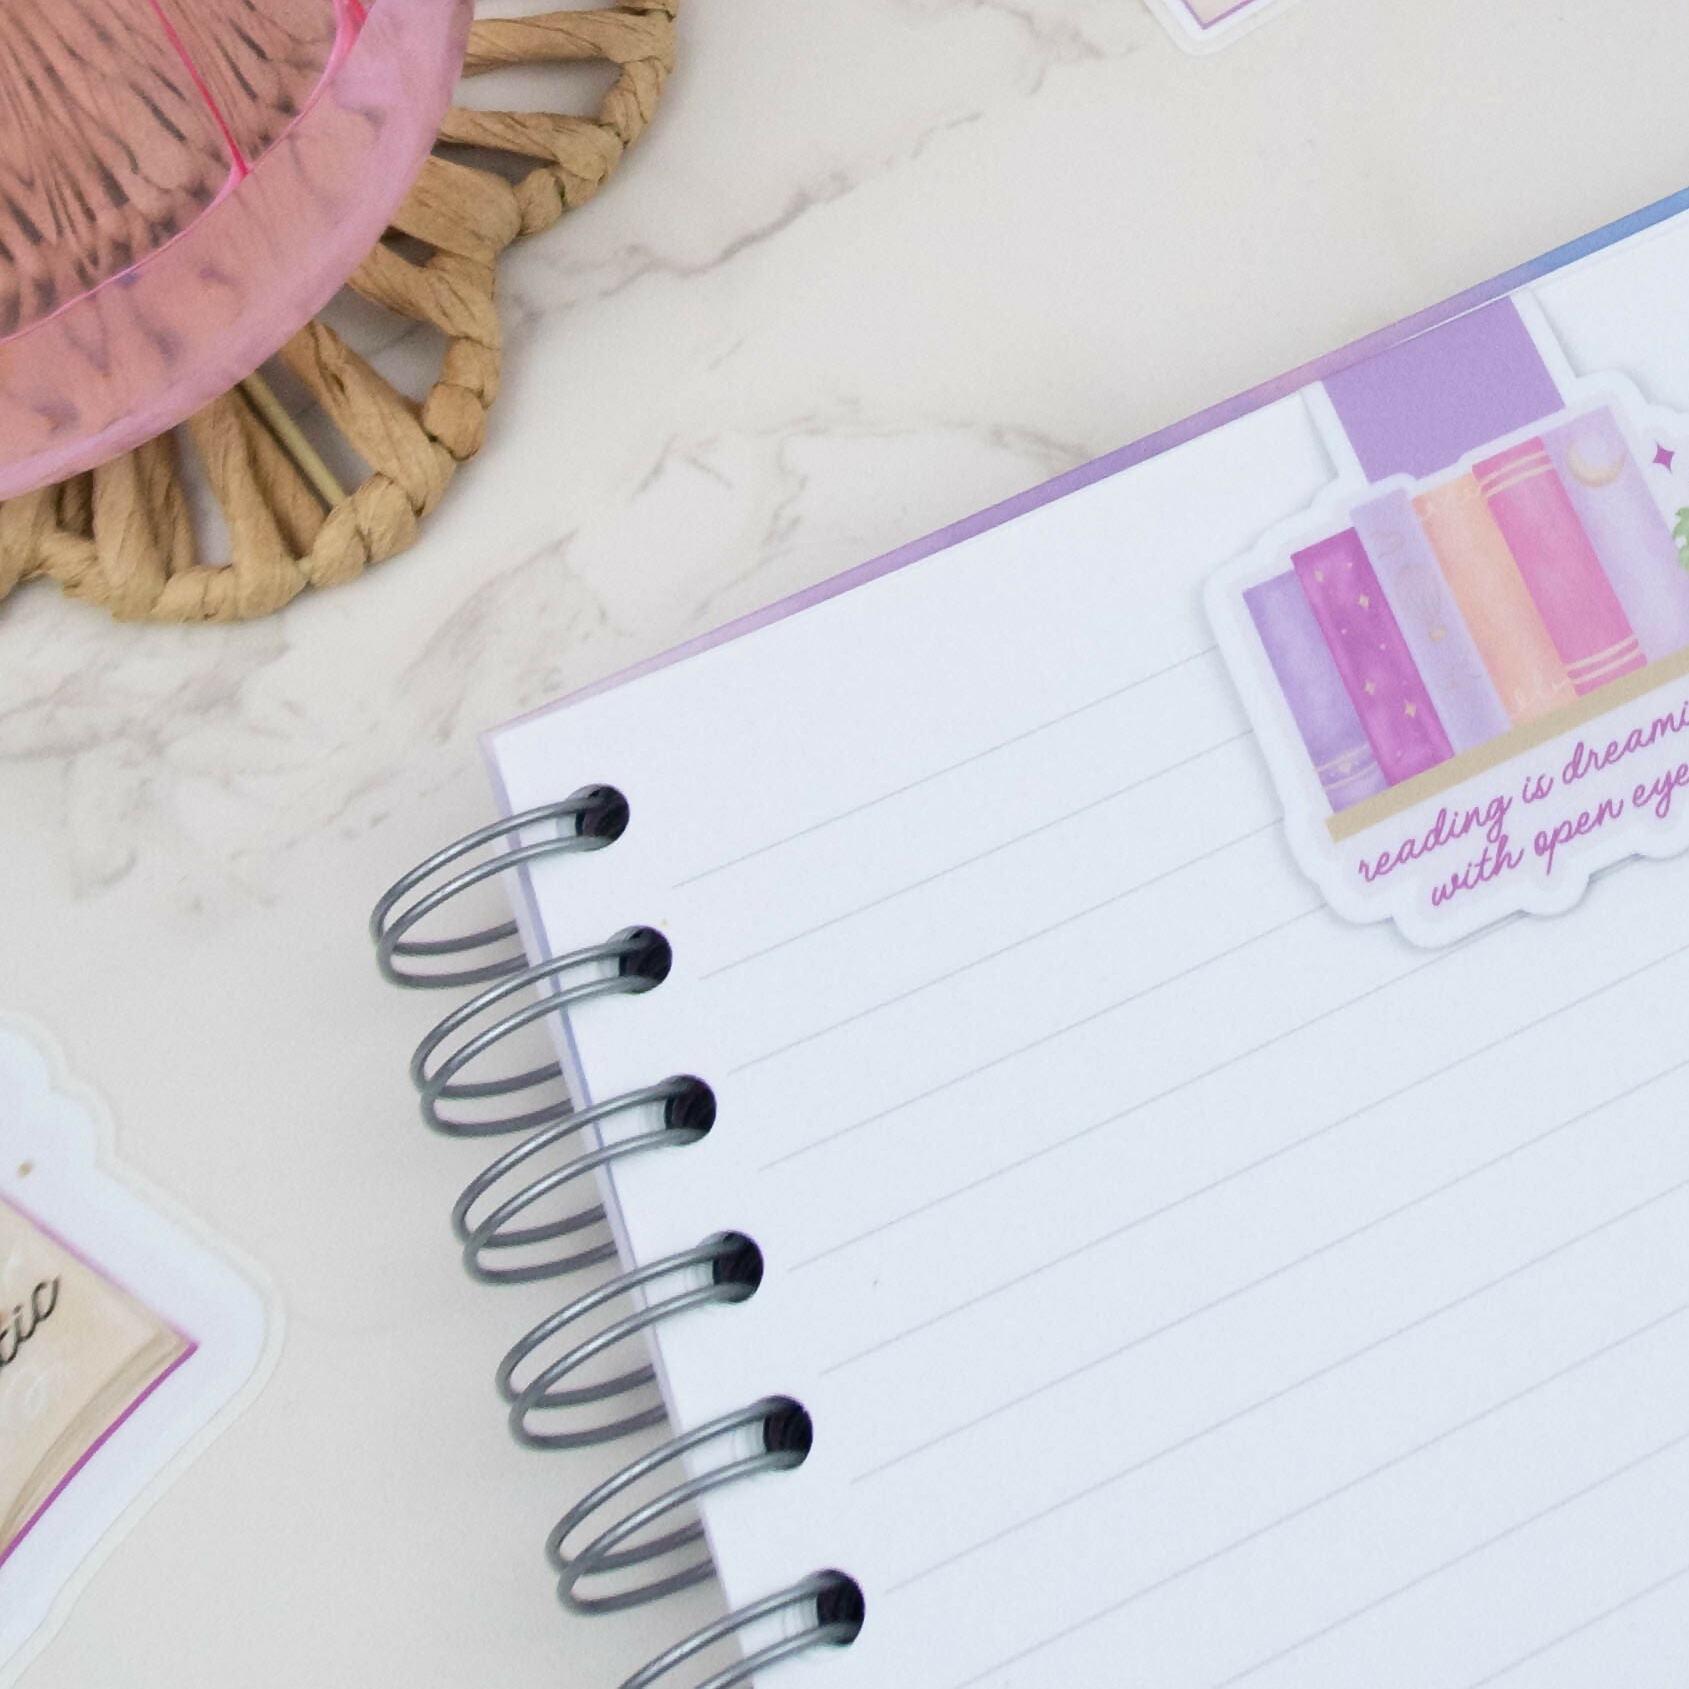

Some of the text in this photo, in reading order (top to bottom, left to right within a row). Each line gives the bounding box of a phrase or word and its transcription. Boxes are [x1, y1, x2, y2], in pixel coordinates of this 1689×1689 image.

[1358, 794, 1514, 883] reading
[1521, 773, 1555, 805] is
[1431, 834, 1525, 907] with
[1533, 797, 1625, 877] open
[0, 1274, 62, 1367] ic
